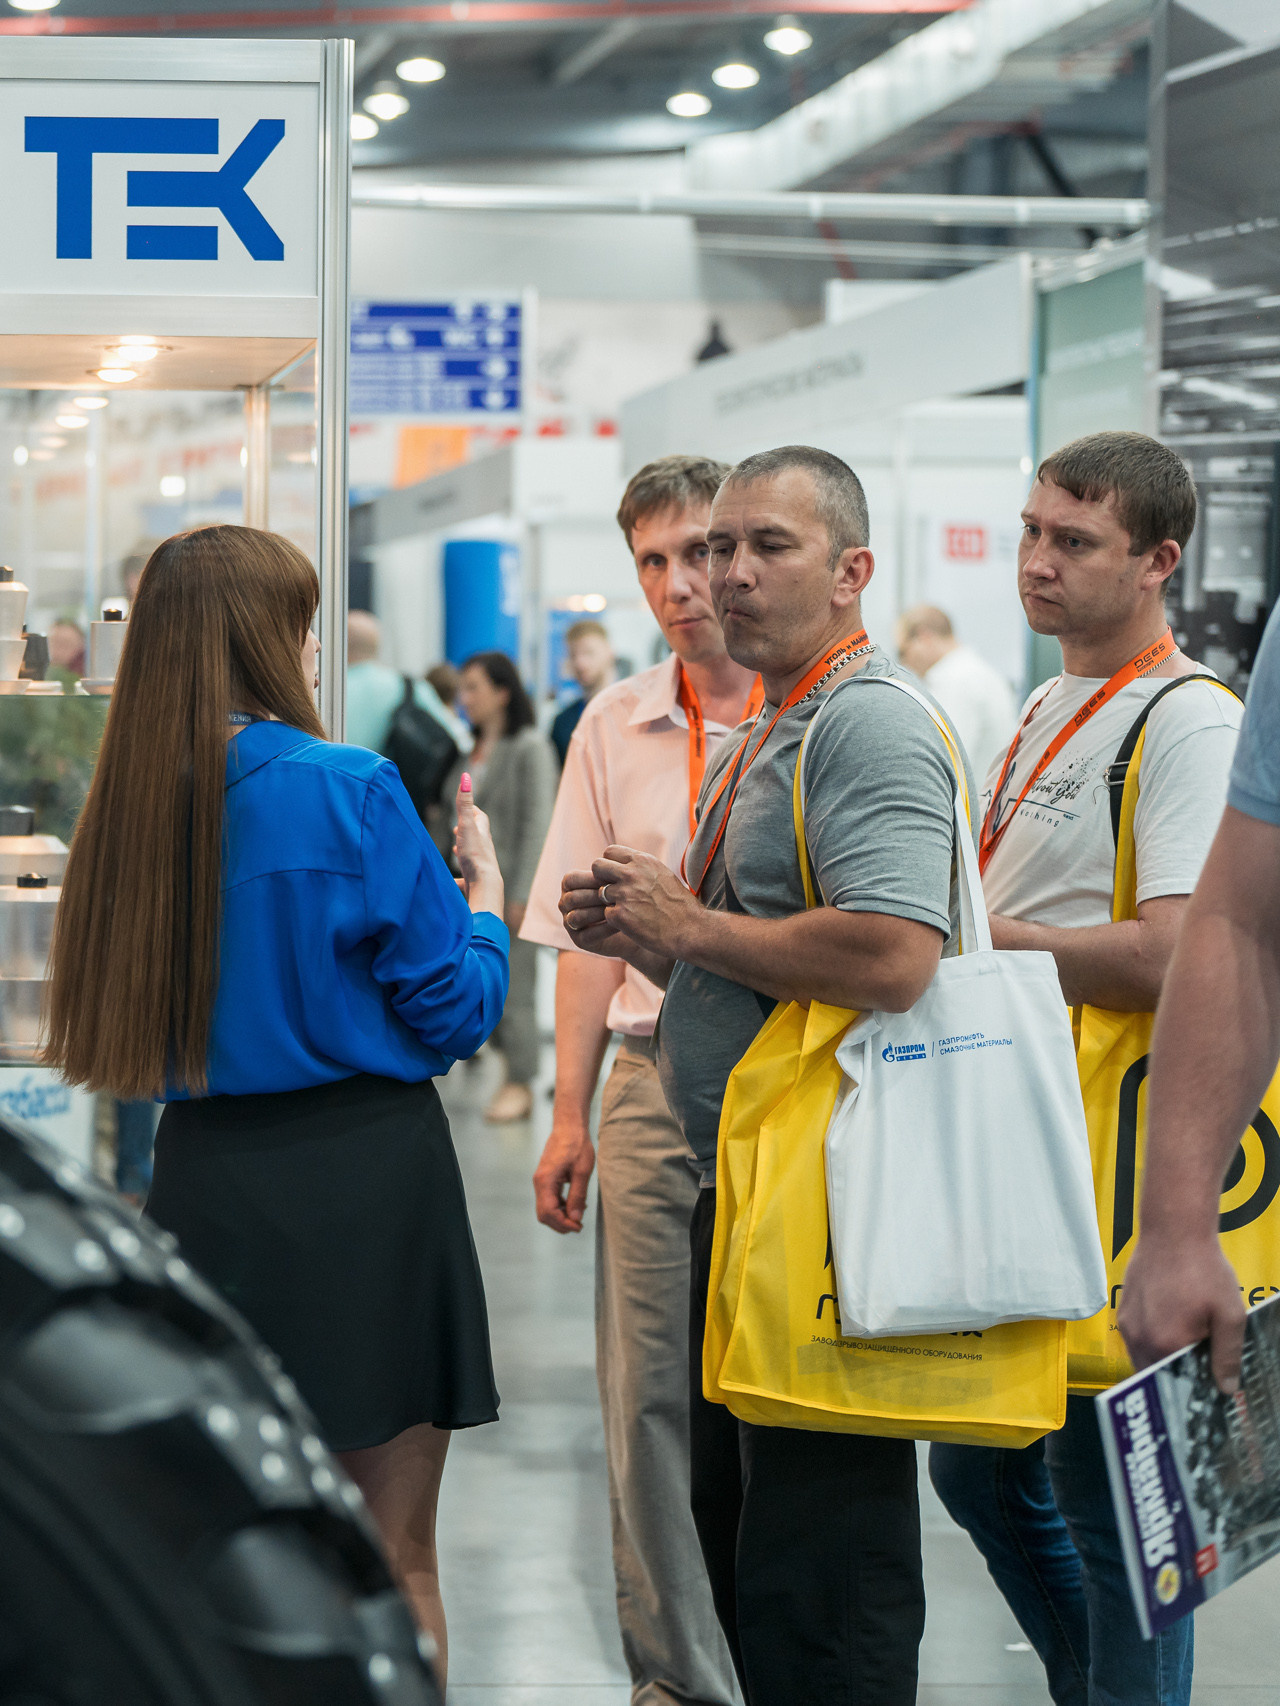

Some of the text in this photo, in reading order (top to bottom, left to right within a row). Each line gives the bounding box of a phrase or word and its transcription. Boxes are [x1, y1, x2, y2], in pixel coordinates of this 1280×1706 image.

[894, 1043, 926, 1055] ГАЗПРОМ
[976, 1038, 1013, 1050] МАТЕРИАЛЫ
[836, 1340, 921, 1356] ЗРЫВОЗАЩИЩЕННОГО
[922, 1349, 983, 1361] ОБОРУДОВАНИЯ
